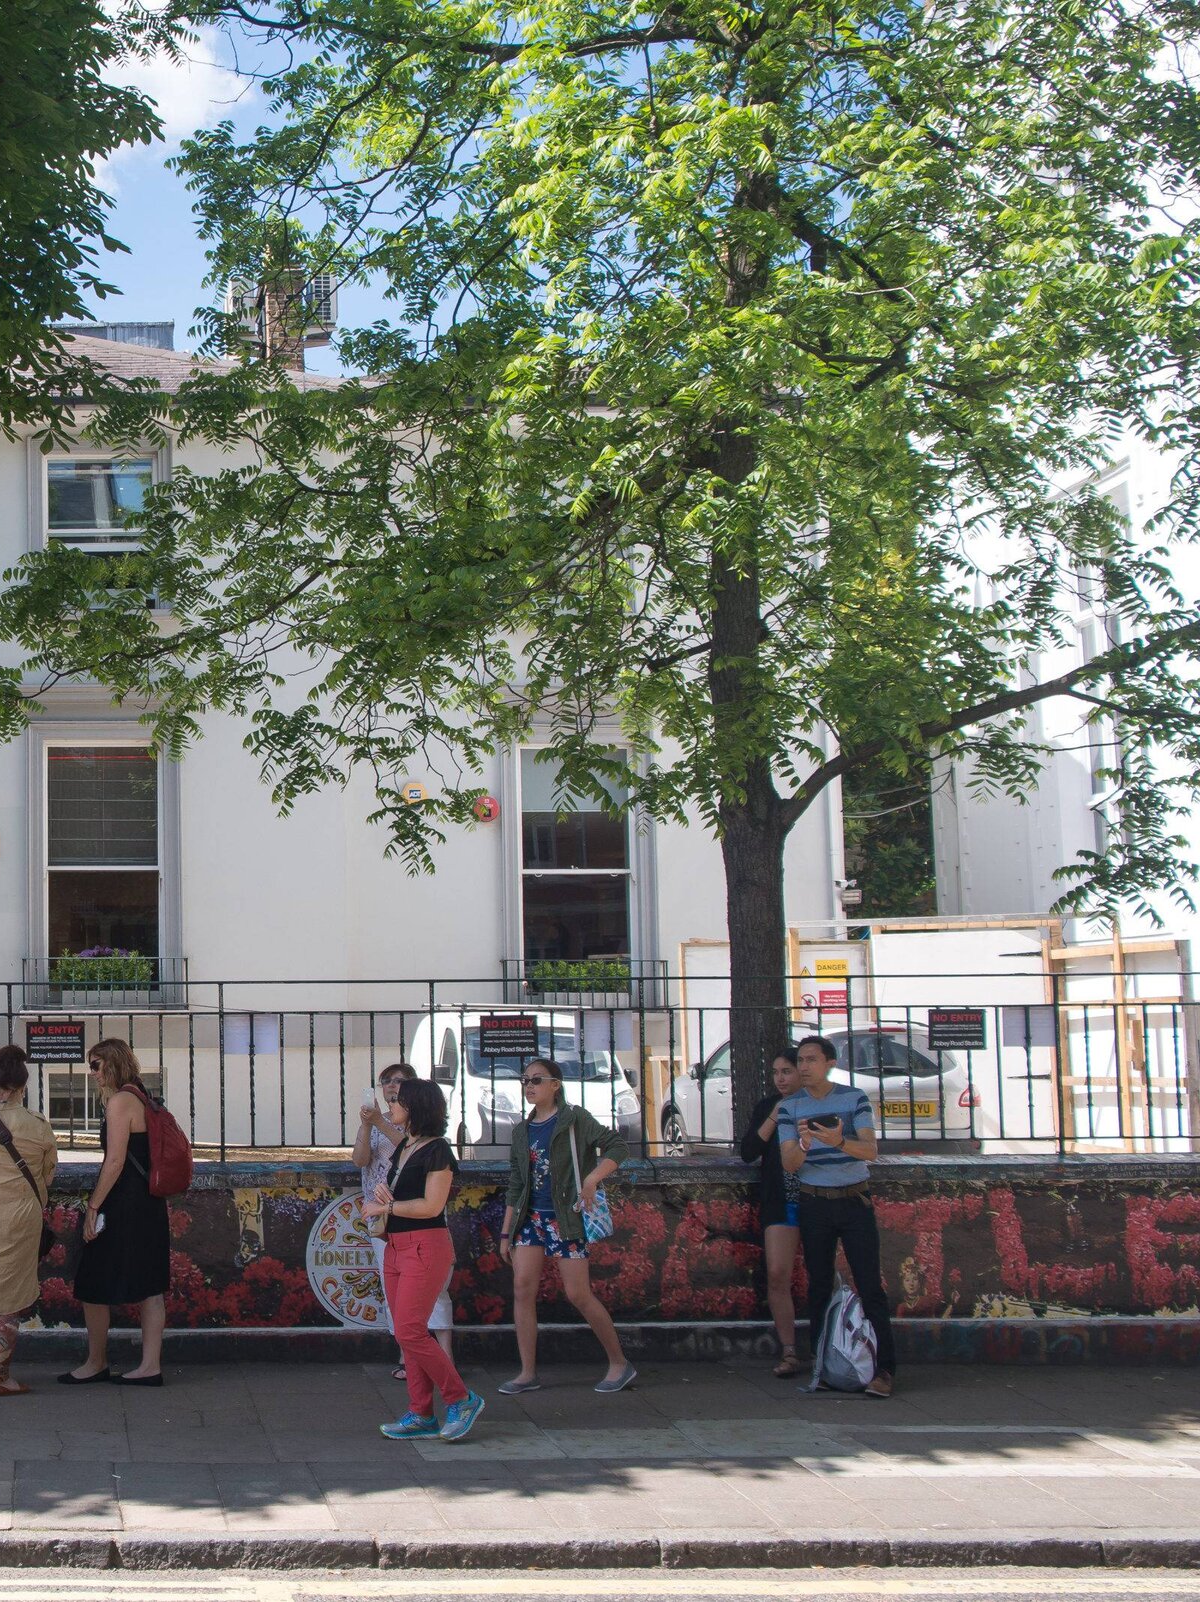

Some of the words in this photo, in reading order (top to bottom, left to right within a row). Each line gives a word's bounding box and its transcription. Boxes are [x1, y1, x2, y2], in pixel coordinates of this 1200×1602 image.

[933, 1014, 947, 1022] NO
[950, 1014, 982, 1022] ENTRY
[502, 1020, 533, 1028] ENTRY
[31, 1026, 45, 1034] NO
[48, 1026, 81, 1034] ENTRY
[314, 1250, 376, 1266] LONELY
[322, 1277, 377, 1322] CLUB
